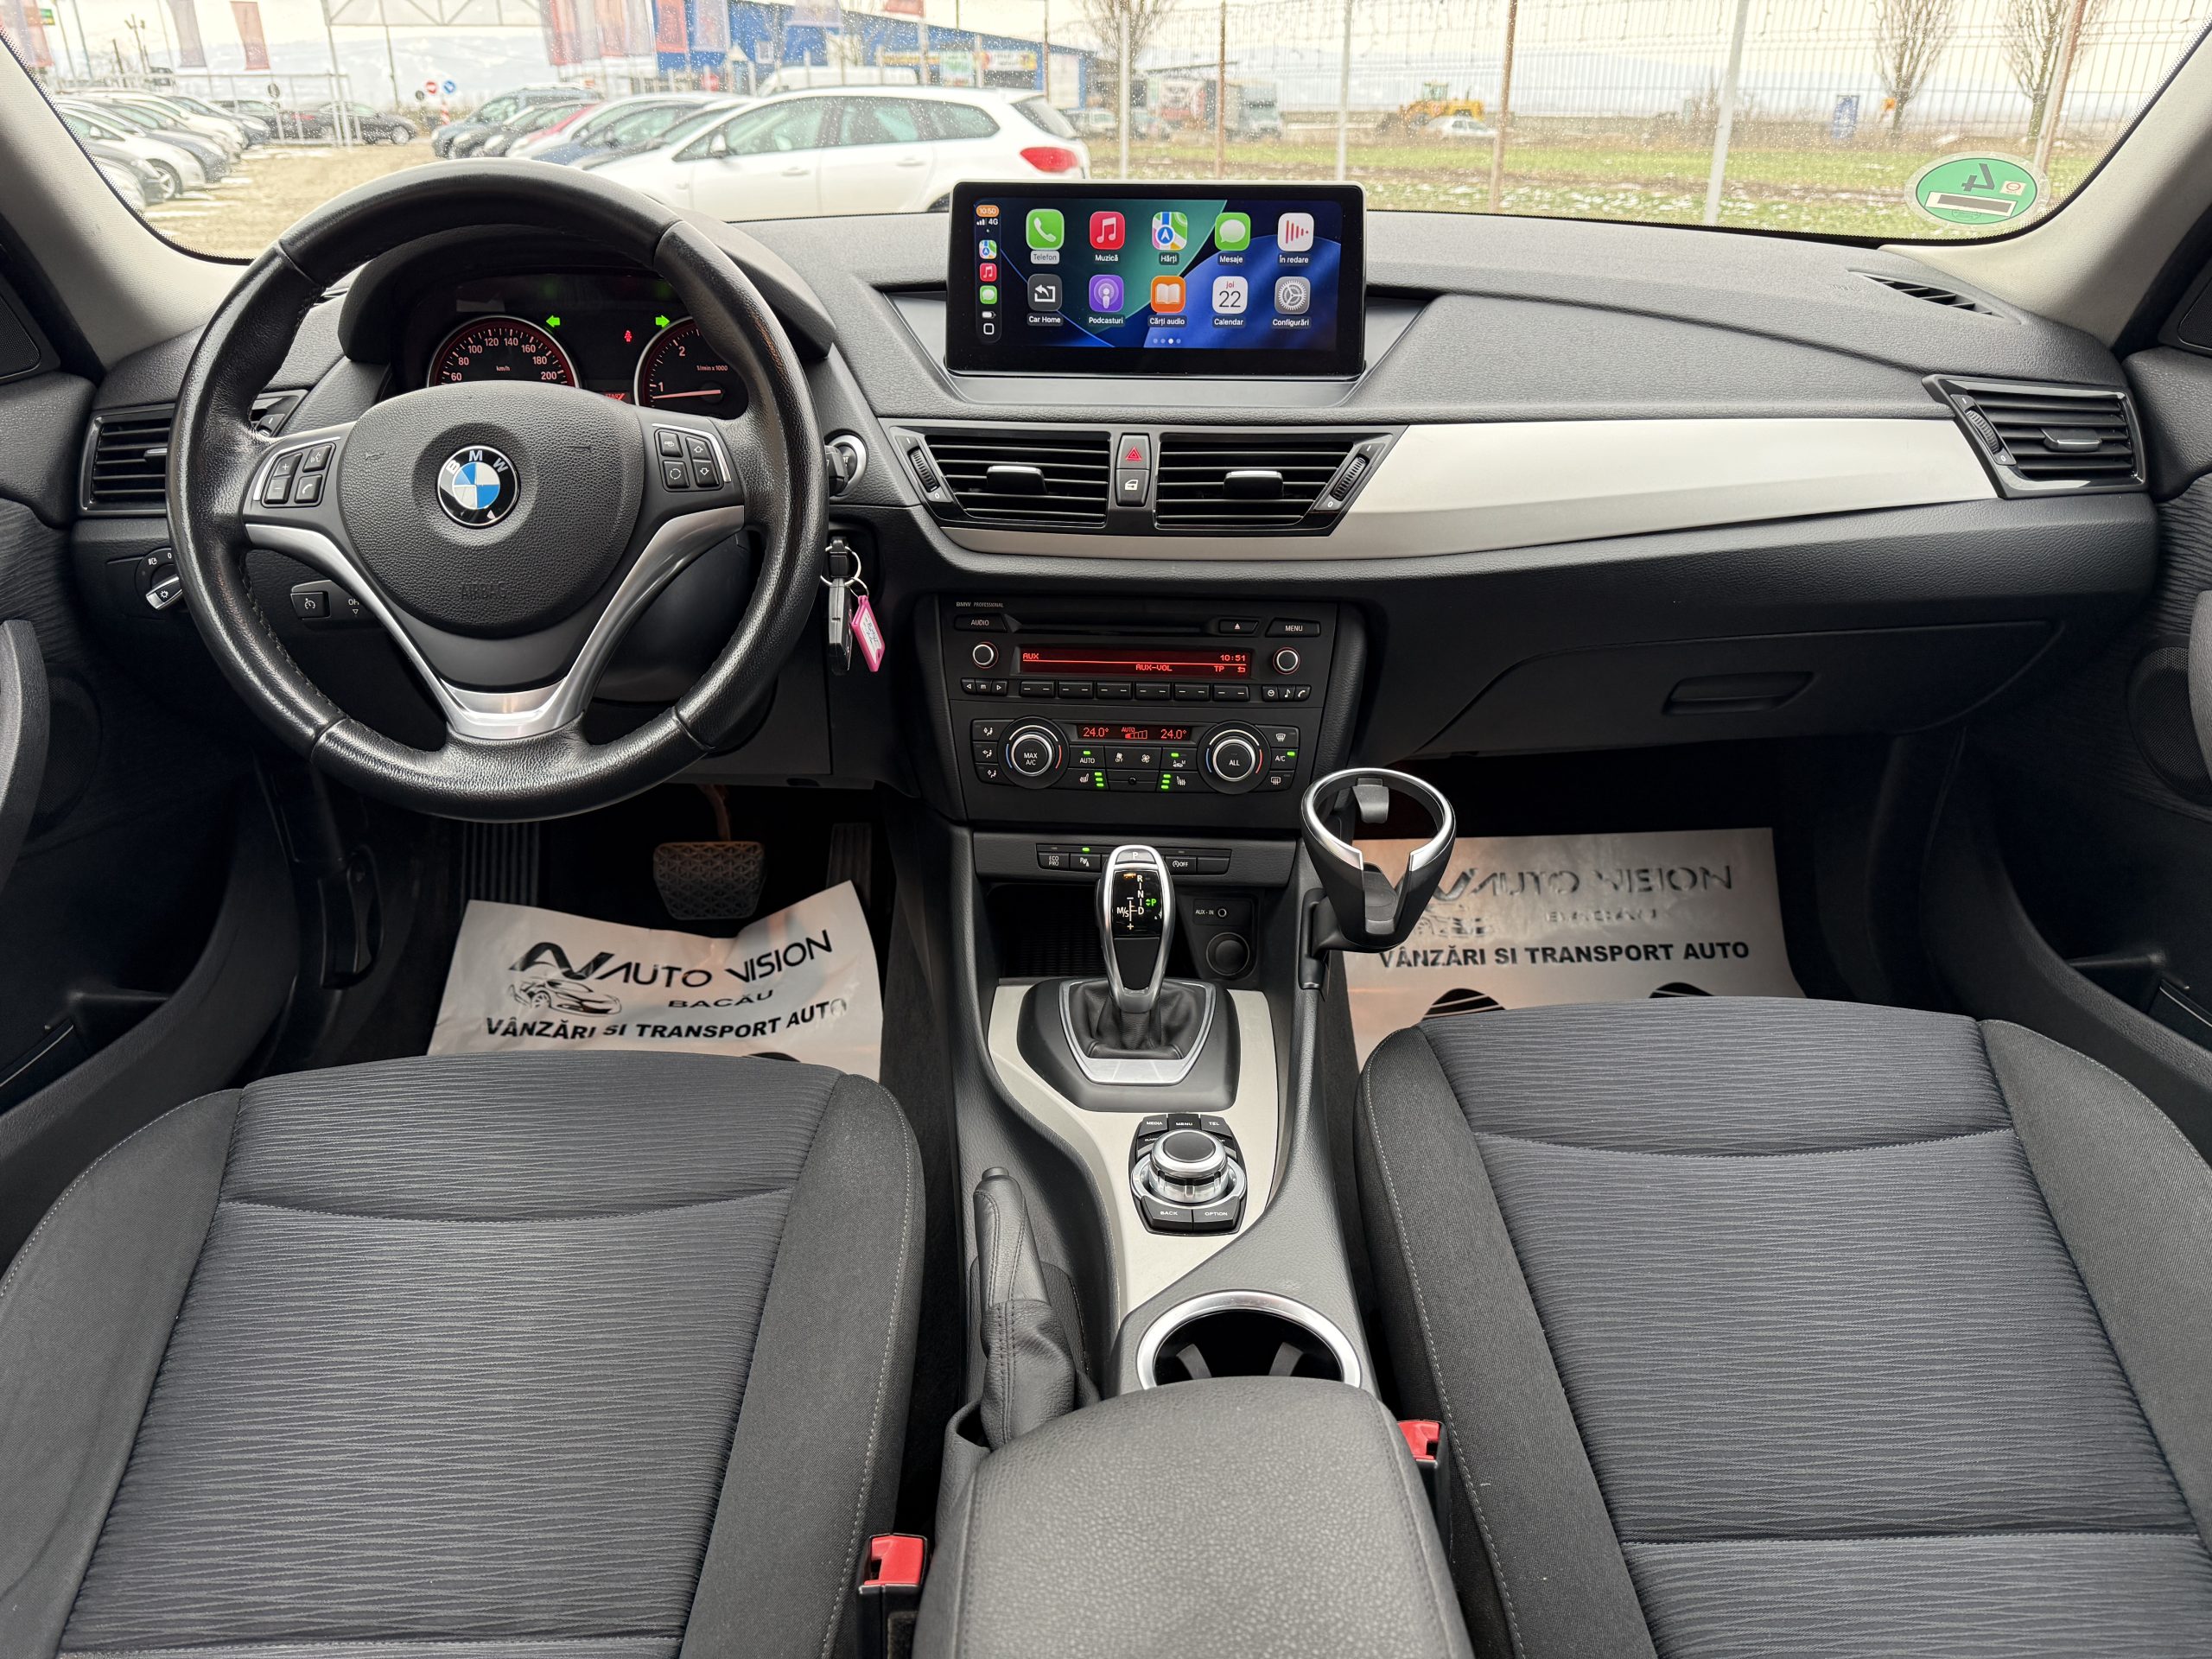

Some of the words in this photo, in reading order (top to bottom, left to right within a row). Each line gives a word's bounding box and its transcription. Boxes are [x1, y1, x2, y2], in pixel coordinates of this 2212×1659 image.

[1219, 290, 1241, 308] 22
[1273, 318, 1309, 327] Configurări
[679, 346, 685, 356] 2
[458, 357, 469, 365] 80
[532, 356, 547, 365] 180
[451, 372, 462, 381] 60
[658, 382, 664, 391] 1
[445, 449, 509, 475] BMW
[1160, 729, 1186, 740] 24.0°
[1471, 871, 1580, 896] AUTO
[1594, 865, 1732, 893] VISION
[594, 962, 712, 988] AUTO
[725, 929, 833, 982] VISION
[1380, 945, 1486, 968] VÂNZĂRI
[1495, 948, 1517, 964] SI
[1524, 944, 1674, 963] TRANSPORT
[1683, 941, 1749, 959] AUTO
[486, 1016, 596, 1039] VÂNZĂRI
[603, 1024, 626, 1036] SI
[636, 1017, 781, 1038] TRANSPORT
[786, 998, 847, 1028] AUTO
